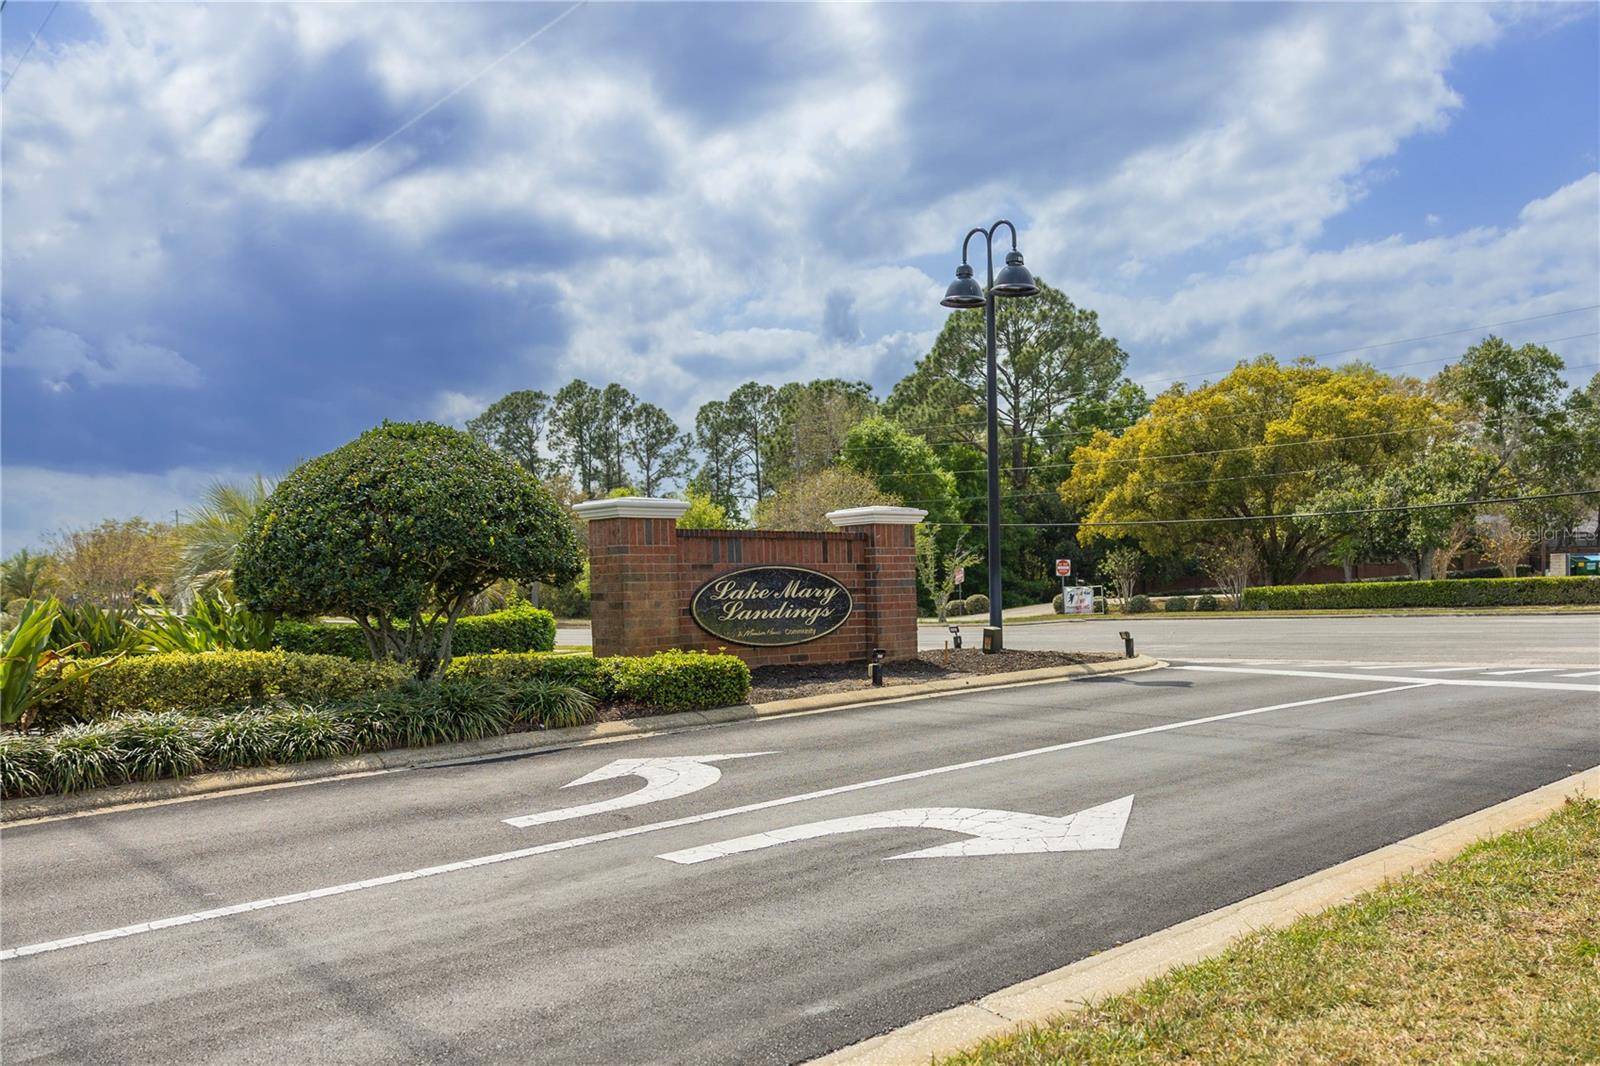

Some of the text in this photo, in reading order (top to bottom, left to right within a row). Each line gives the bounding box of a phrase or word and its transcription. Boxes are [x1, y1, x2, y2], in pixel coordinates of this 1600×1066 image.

[710, 580, 840, 605] Lake Mary
[718, 601, 835, 625] Landings
